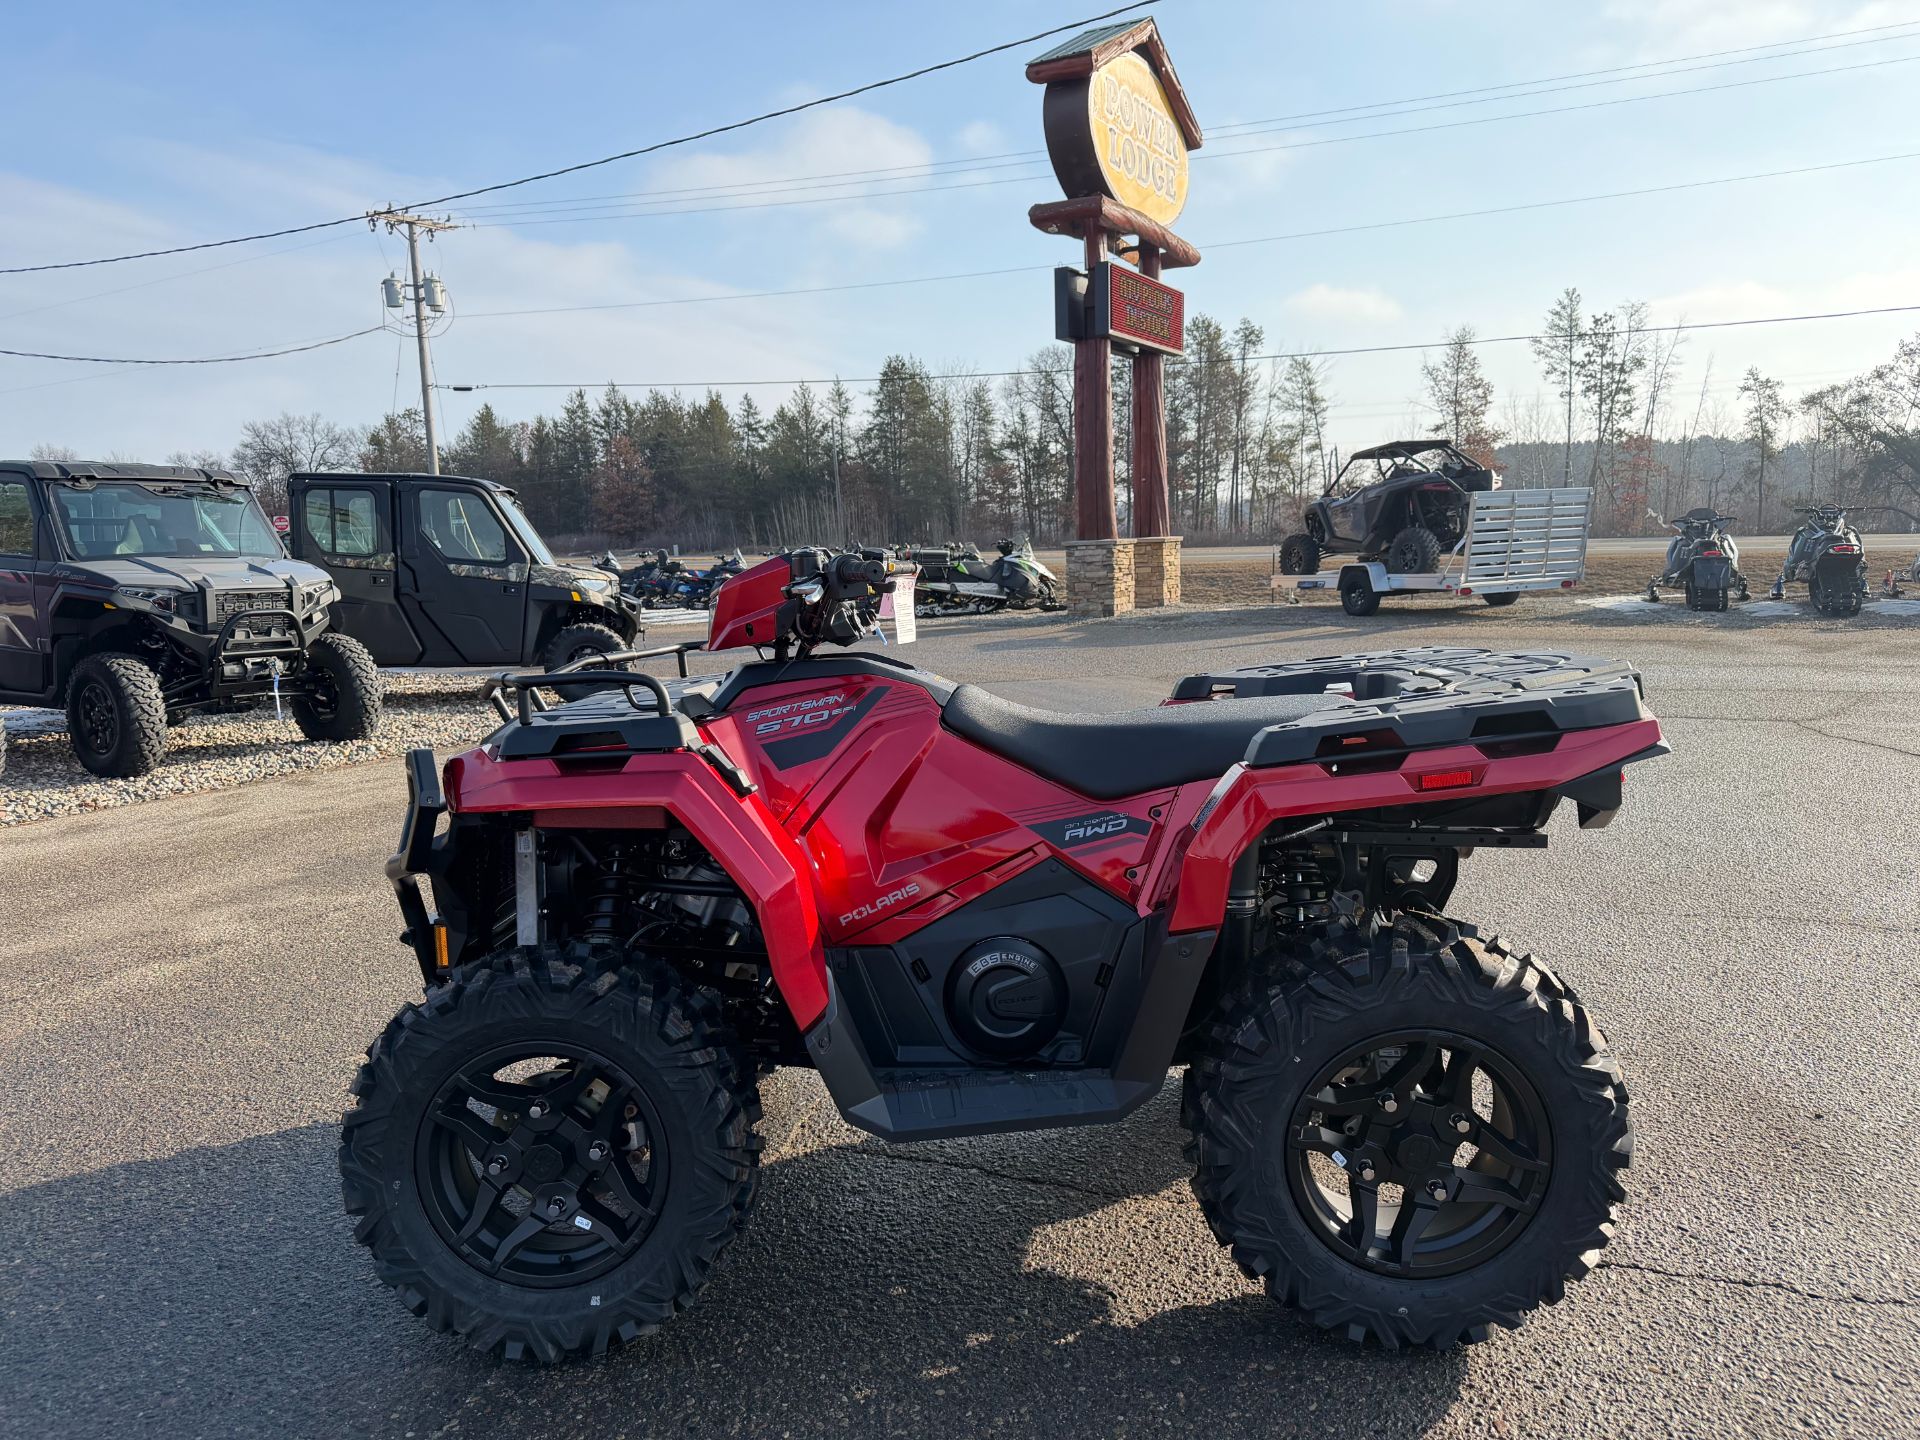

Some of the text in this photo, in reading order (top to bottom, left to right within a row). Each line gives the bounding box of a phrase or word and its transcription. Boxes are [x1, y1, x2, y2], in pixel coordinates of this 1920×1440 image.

[1105, 76, 1179, 161] POWER
[1109, 127, 1176, 201] LODGE
[54, 569, 71, 578] XP
[224, 601, 287, 613] POLARIS
[745, 693, 846, 723] SPORTSMAN
[755, 705, 857, 735] 570 EFI
[1064, 819, 1128, 841] AWD
[838, 882, 920, 927] POLARIS
[970, 953, 1037, 974] EBS ENGINE
